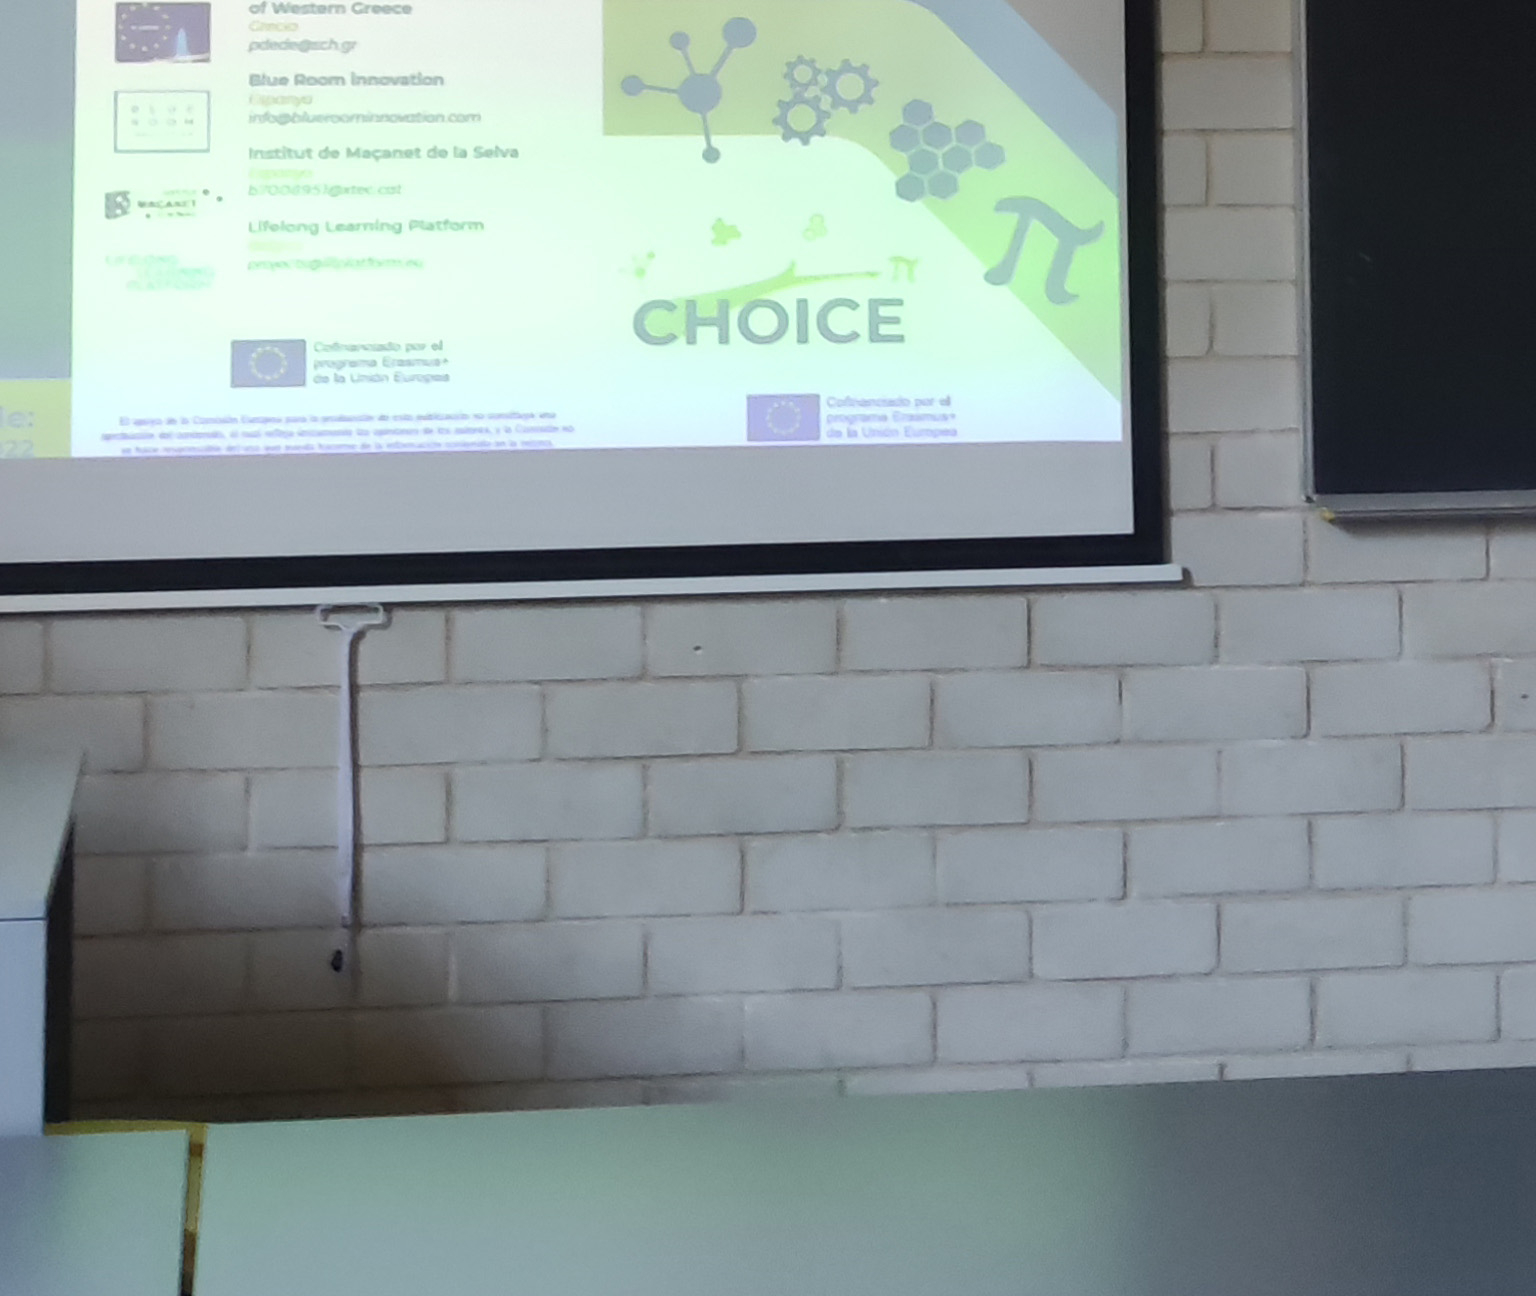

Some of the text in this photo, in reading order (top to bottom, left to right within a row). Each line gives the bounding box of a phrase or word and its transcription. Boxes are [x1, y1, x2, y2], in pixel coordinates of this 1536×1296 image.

[249, 2, 412, 15] of Western Greece
[249, 73, 289, 87] Blue
[294, 73, 345, 87] Room
[249, 145, 519, 163] Institut de Maçanet de la Selva
[248, 219, 485, 235] Lifelong Learning Platform
[633, 297, 905, 346] CHOICE
[405, 343, 429, 354] por
[432, 340, 443, 352] el
